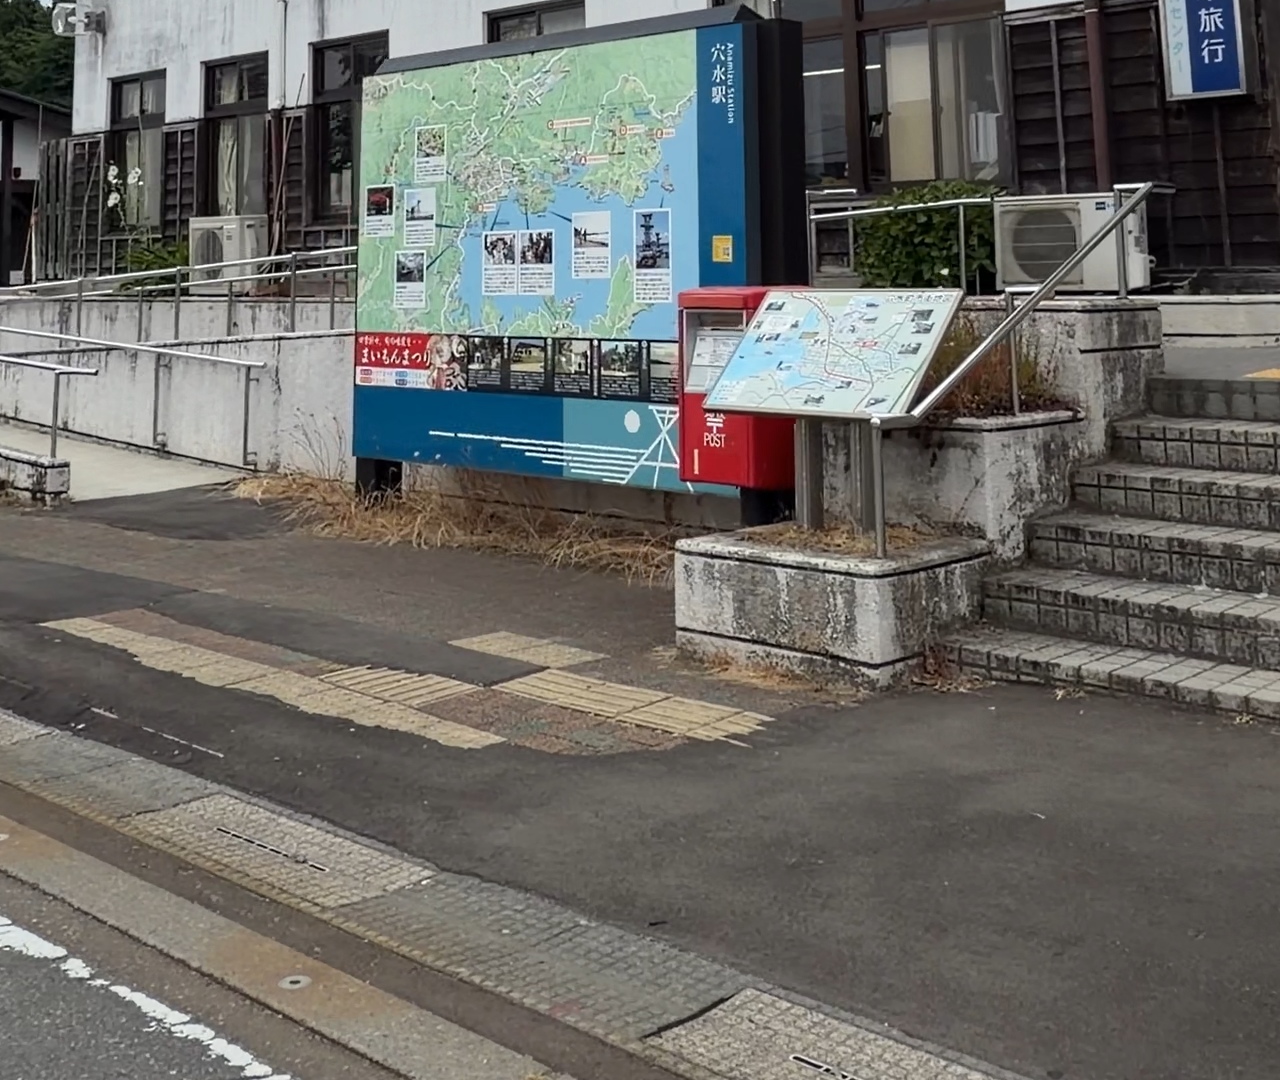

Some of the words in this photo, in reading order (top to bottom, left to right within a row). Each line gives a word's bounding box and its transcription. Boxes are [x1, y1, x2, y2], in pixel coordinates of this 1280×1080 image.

[710, 42, 726, 105] 穴水駅
[726, 42, 735, 86] Anamizu
[727, 87, 735, 124] Station
[361, 347, 431, 367] まいもんまつり
[703, 432, 726, 448] POST
